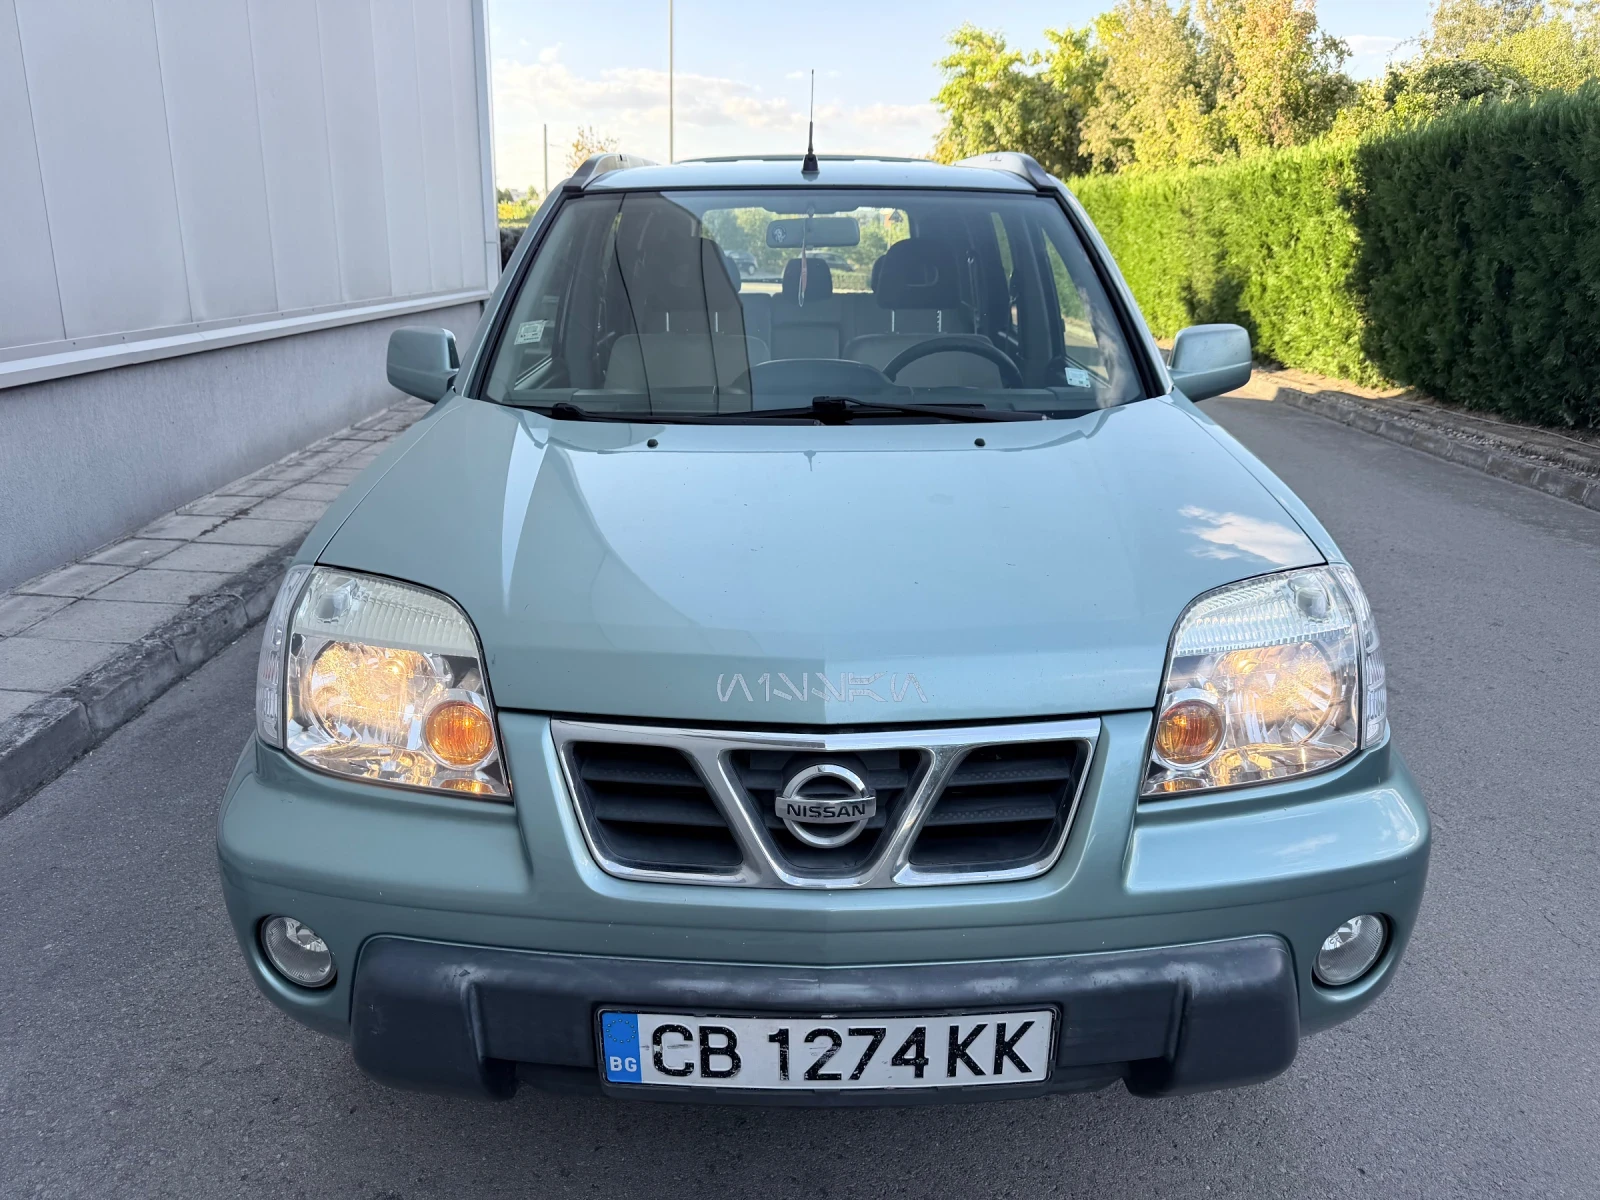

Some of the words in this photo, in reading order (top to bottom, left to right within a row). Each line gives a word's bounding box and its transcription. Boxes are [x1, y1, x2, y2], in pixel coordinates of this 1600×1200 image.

[787, 803, 866, 818] NISSAN
[652, 1023, 743, 1079] CB
[768, 1026, 930, 1081] 1274
[946, 1020, 1036, 1078] KK
[609, 1056, 638, 1073] BG
